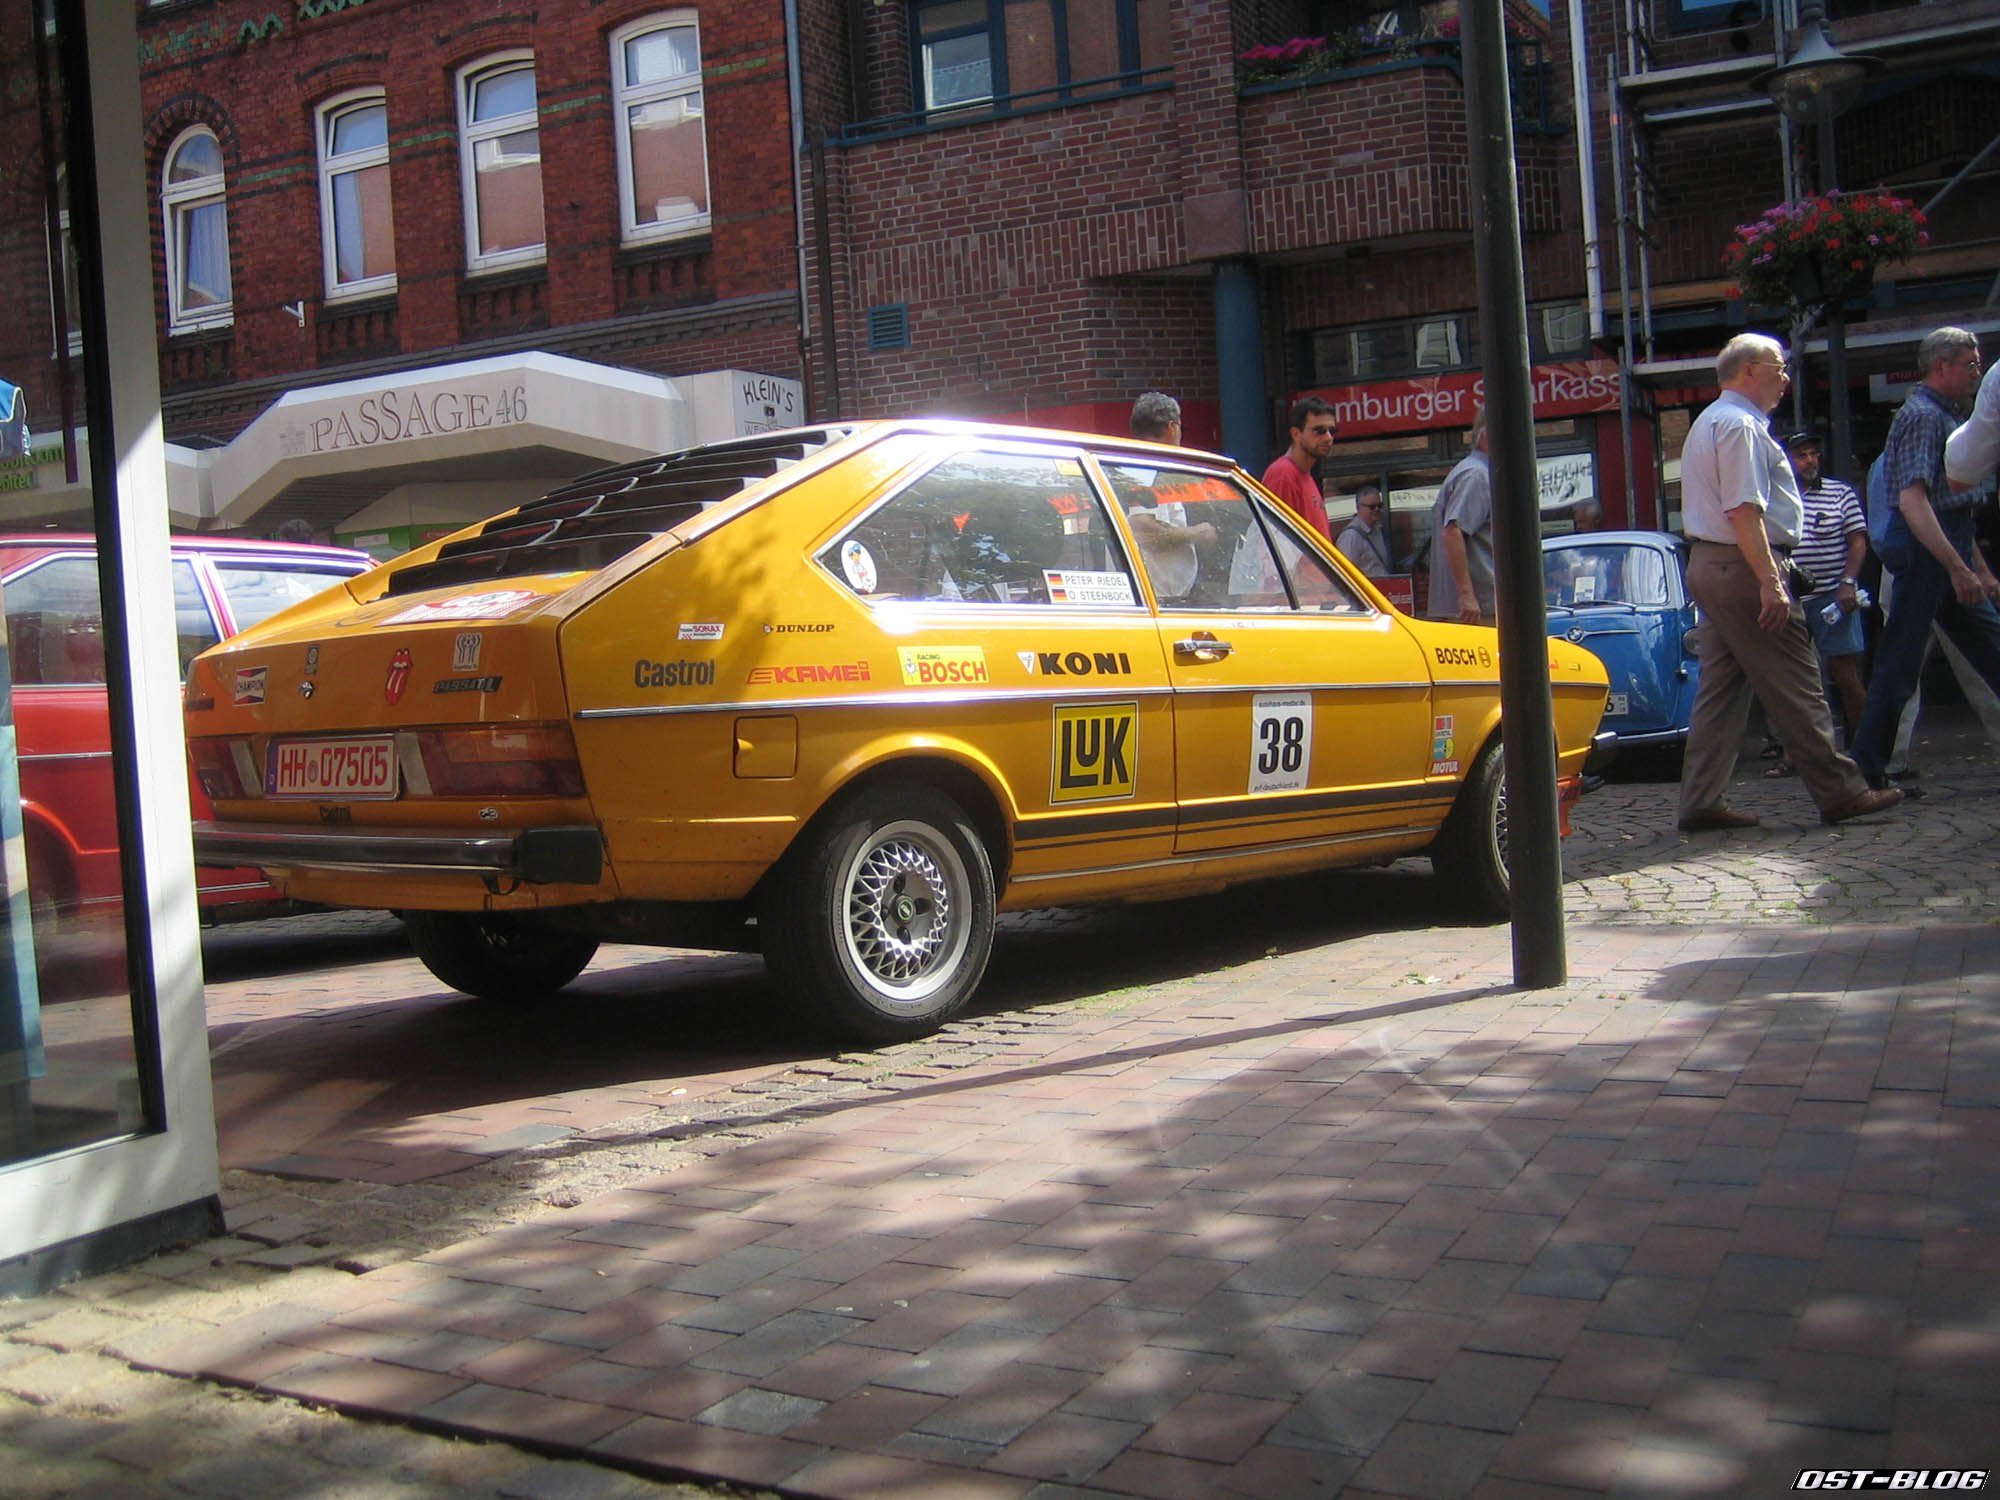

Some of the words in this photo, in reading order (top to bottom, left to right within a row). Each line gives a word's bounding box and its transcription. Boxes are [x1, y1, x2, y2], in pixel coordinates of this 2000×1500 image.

[742, 379, 795, 413] KLEIN'S
[1335, 388, 1465, 422] mburger
[310, 391, 492, 451] PASSAGE
[495, 386, 528, 424] 46
[1065, 575, 1093, 586] PETER
[1096, 576, 1128, 587] RIEDEL
[693, 625, 721, 633] SONAX
[776, 624, 835, 633] DUNLOP
[1037, 652, 1132, 676] KONI
[1434, 647, 1478, 666] BOSCH
[634, 658, 715, 688] Castrol
[918, 660, 988, 684] BOSCH
[1258, 716, 1304, 774] 38
[279, 748, 307, 788] HH
[320, 745, 389, 787] 07505
[1431, 760, 1459, 773] MOTUL
